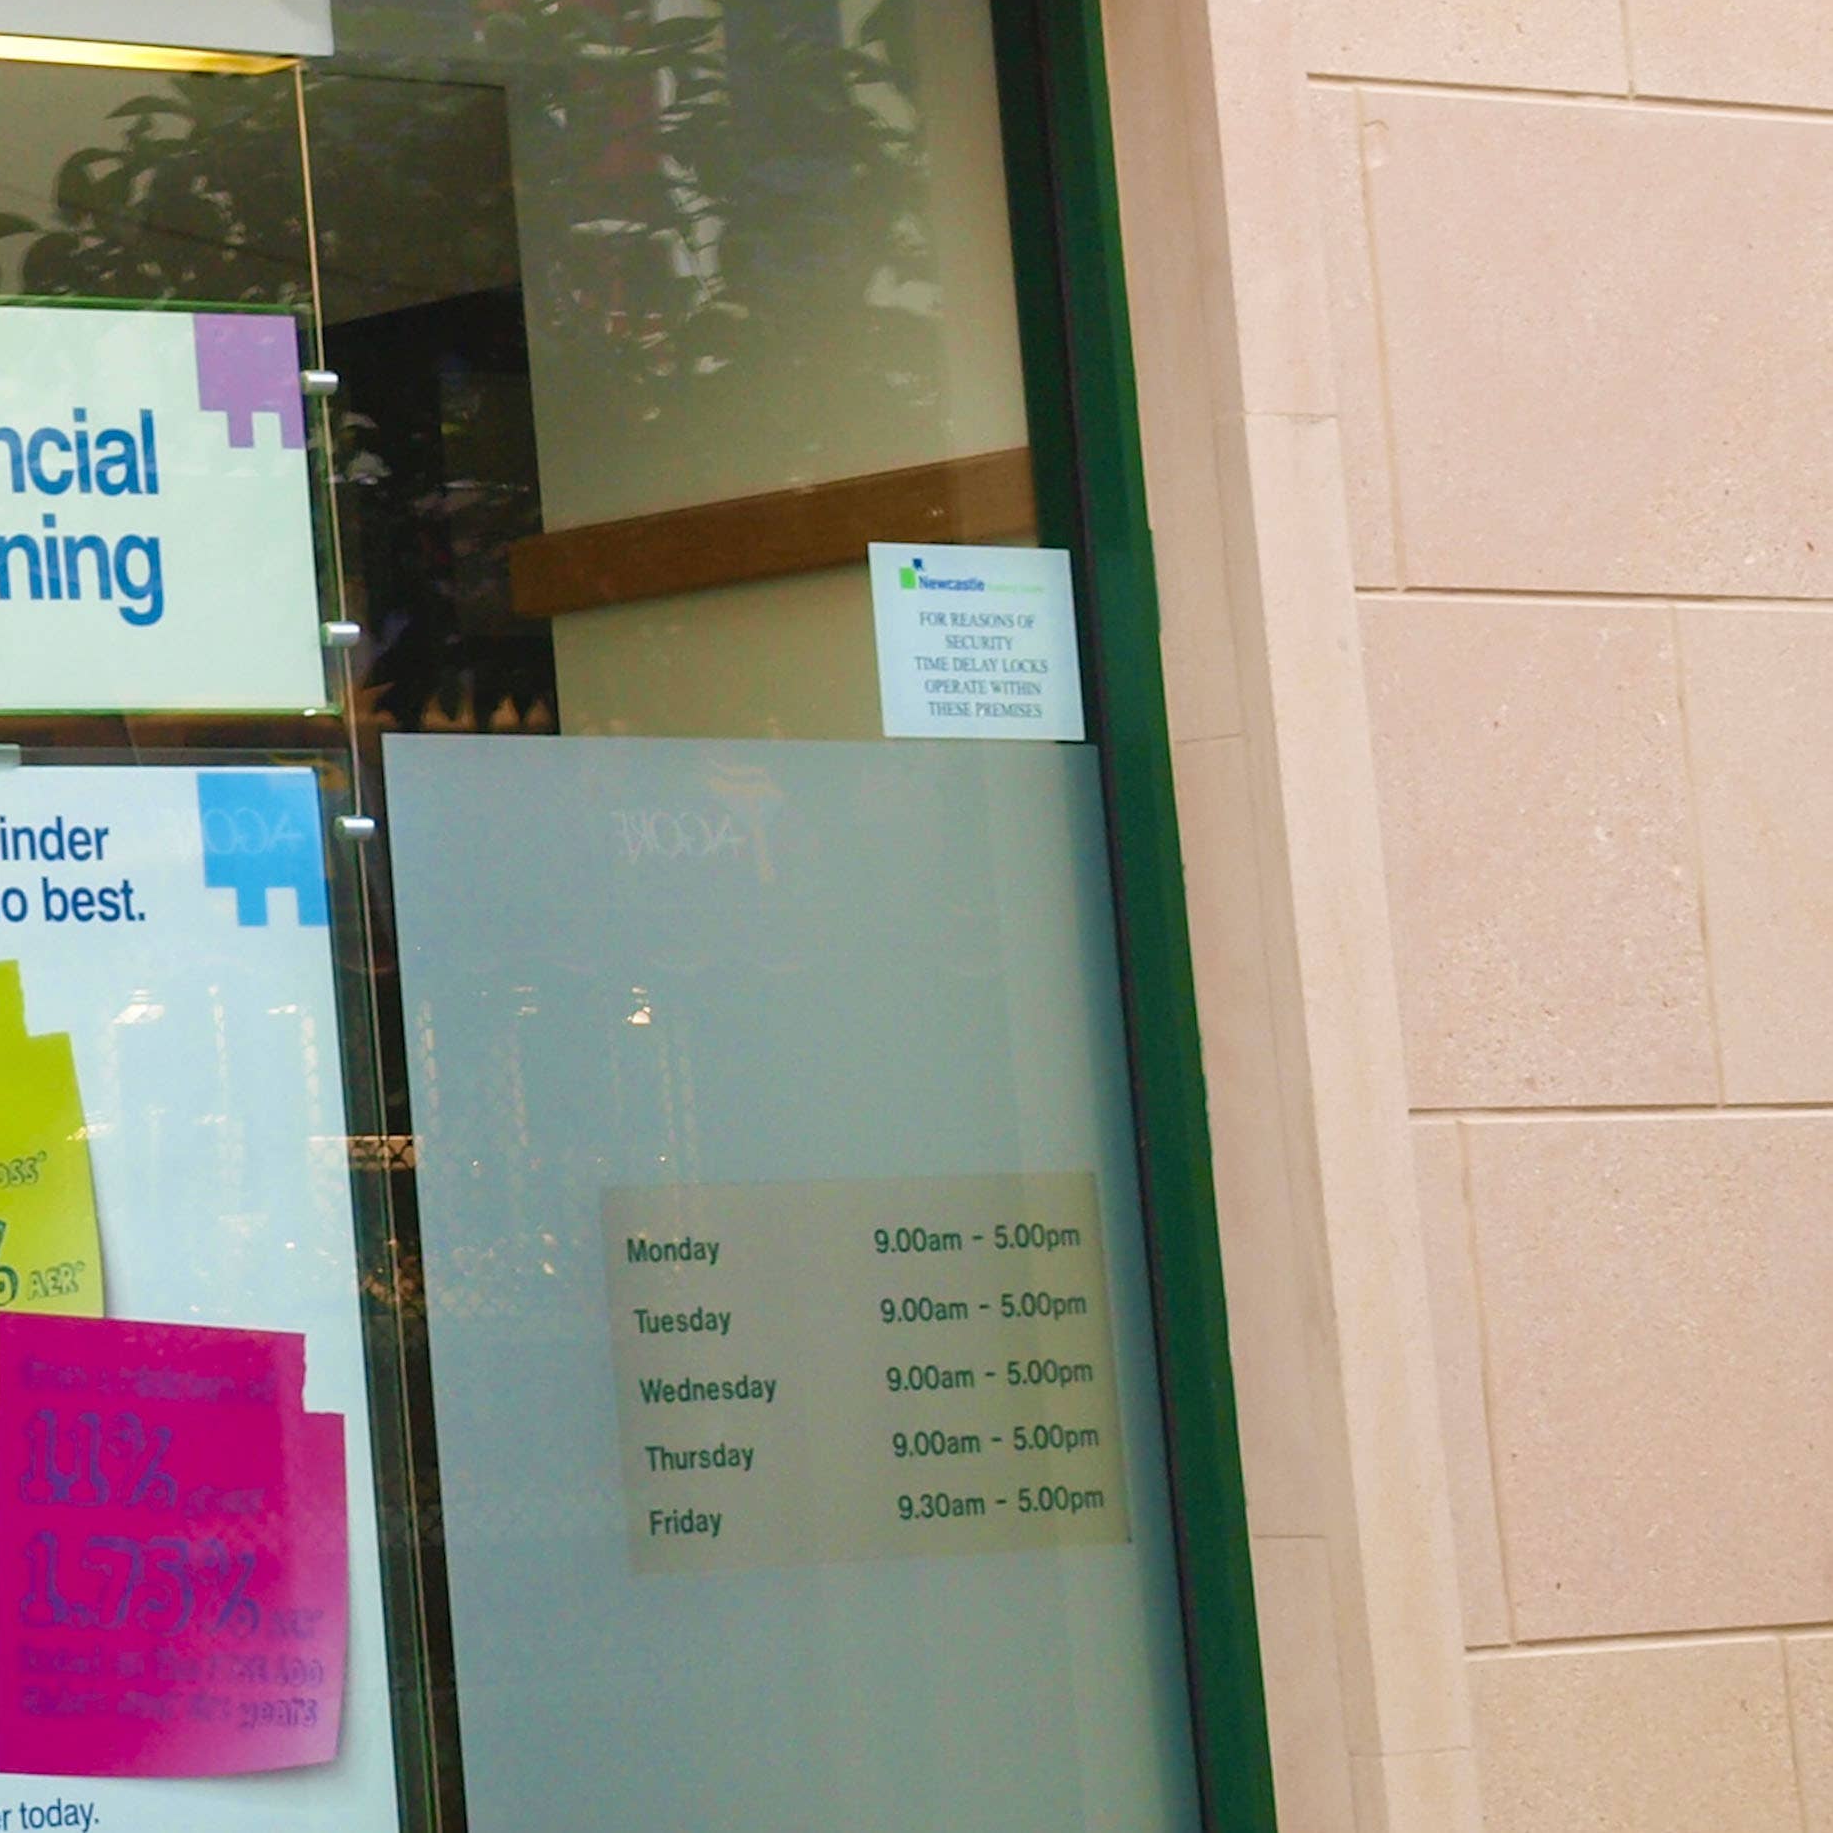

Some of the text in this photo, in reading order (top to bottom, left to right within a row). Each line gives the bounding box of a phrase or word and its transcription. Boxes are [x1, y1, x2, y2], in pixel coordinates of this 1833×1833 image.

[918, 575, 986, 593] Newcastle
[919, 612, 1036, 629] FOR REASONS OF
[944, 634, 1014, 651] SECURITY
[914, 656, 1049, 674] TIME DELAY LOCKS
[924, 679, 1042, 695] OPERATE WITHIN
[928, 701, 1043, 718] THESE PREMISES
[40, 875, 147, 924] best.
[626, 1236, 721, 1265] Monday
[873, 1226, 964, 1254] 9.00am
[993, 1222, 1082, 1253] 5.00pm
[634, 1306, 732, 1336] Tuesday
[879, 1295, 970, 1324] 9.00am
[1000, 1290, 1089, 1321] 5.00pm
[639, 1374, 778, 1405] Wednesday
[885, 1364, 976, 1393] 9.00am
[1006, 1358, 1095, 1390] 5.00pm
[644, 1443, 756, 1474] Thursday
[891, 1430, 982, 1460] 9.00am
[1012, 1423, 1100, 1454] 5.00pm
[648, 1508, 723, 1540] Friday
[897, 1492, 987, 1522] 9.30am
[1017, 1484, 1105, 1515] 5.00pm
[20, 1797, 101, 1833] today.
